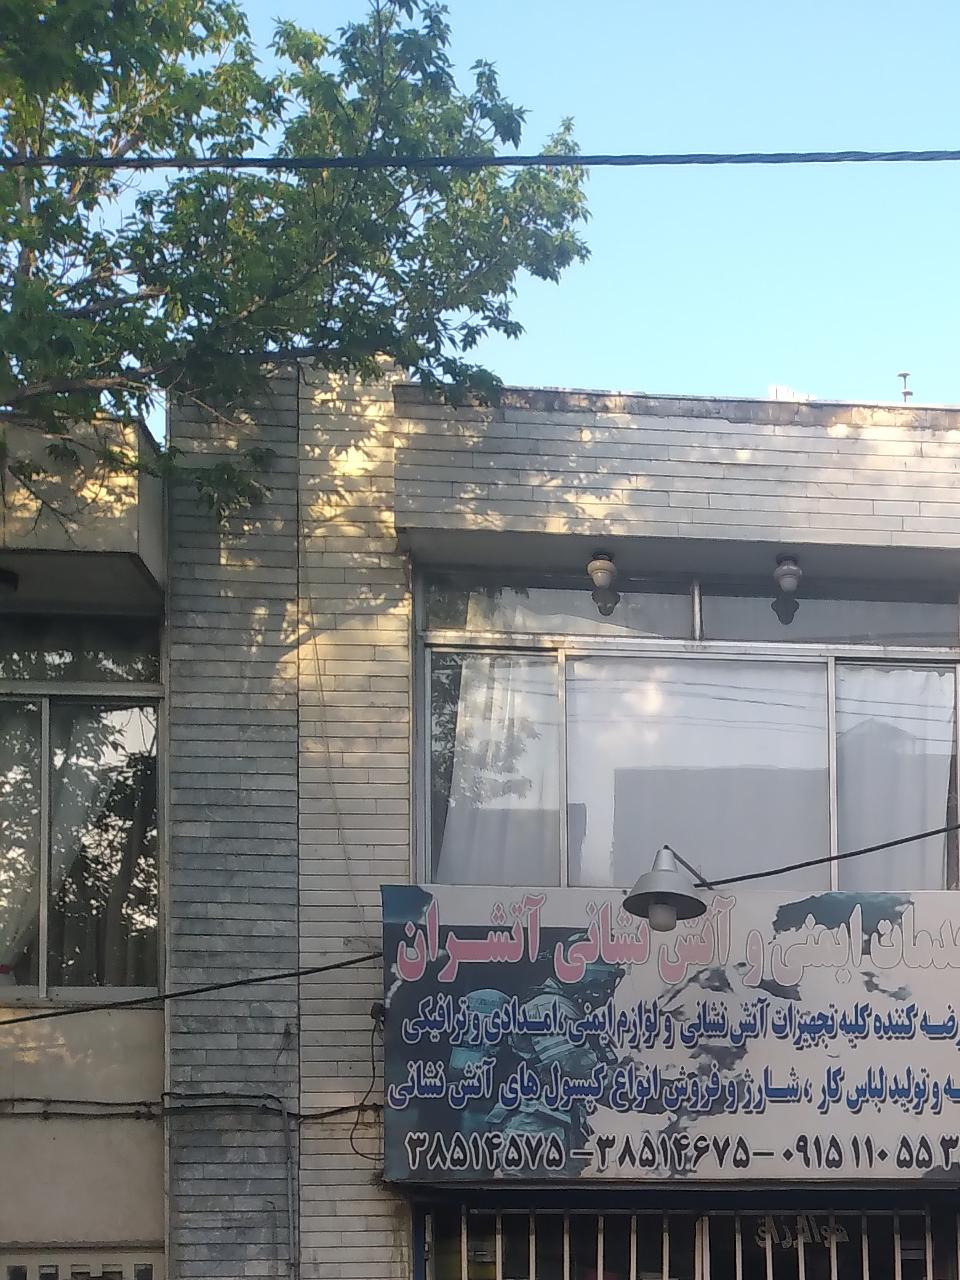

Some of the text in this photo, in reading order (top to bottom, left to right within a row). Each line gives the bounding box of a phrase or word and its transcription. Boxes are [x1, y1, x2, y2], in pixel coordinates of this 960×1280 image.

[658, 895, 737, 985] آتش
[742, 929, 765, 986] و
[771, 902, 863, 986] ایمنی
[402, 992, 469, 1044] ترافیکی
[468, 1010, 482, 1045] و
[616, 998, 660, 1050] لوازم
[663, 1013, 675, 1049] و
[679, 998, 729, 1048] نشانی
[729, 997, 771, 1048] آتش
[771, 1001, 839, 1050] تجهیزات
[838, 1001, 873, 1049] کلیه
[873, 1001, 918, 1042] کننده
[388, 1060, 447, 1110] نشانی
[448, 1057, 497, 1109] آتش
[499, 1060, 541, 1109] های
[542, 1061, 607, 1112] کپسول
[610, 1061, 661, 1111] انواع
[663, 1060, 722, 1113] فروش
[723, 1078, 738, 1115] و
[846, 1065, 888, 1115] لباس
[888, 1065, 930, 1115] تولید
[930, 1078, 943, 1115] و
